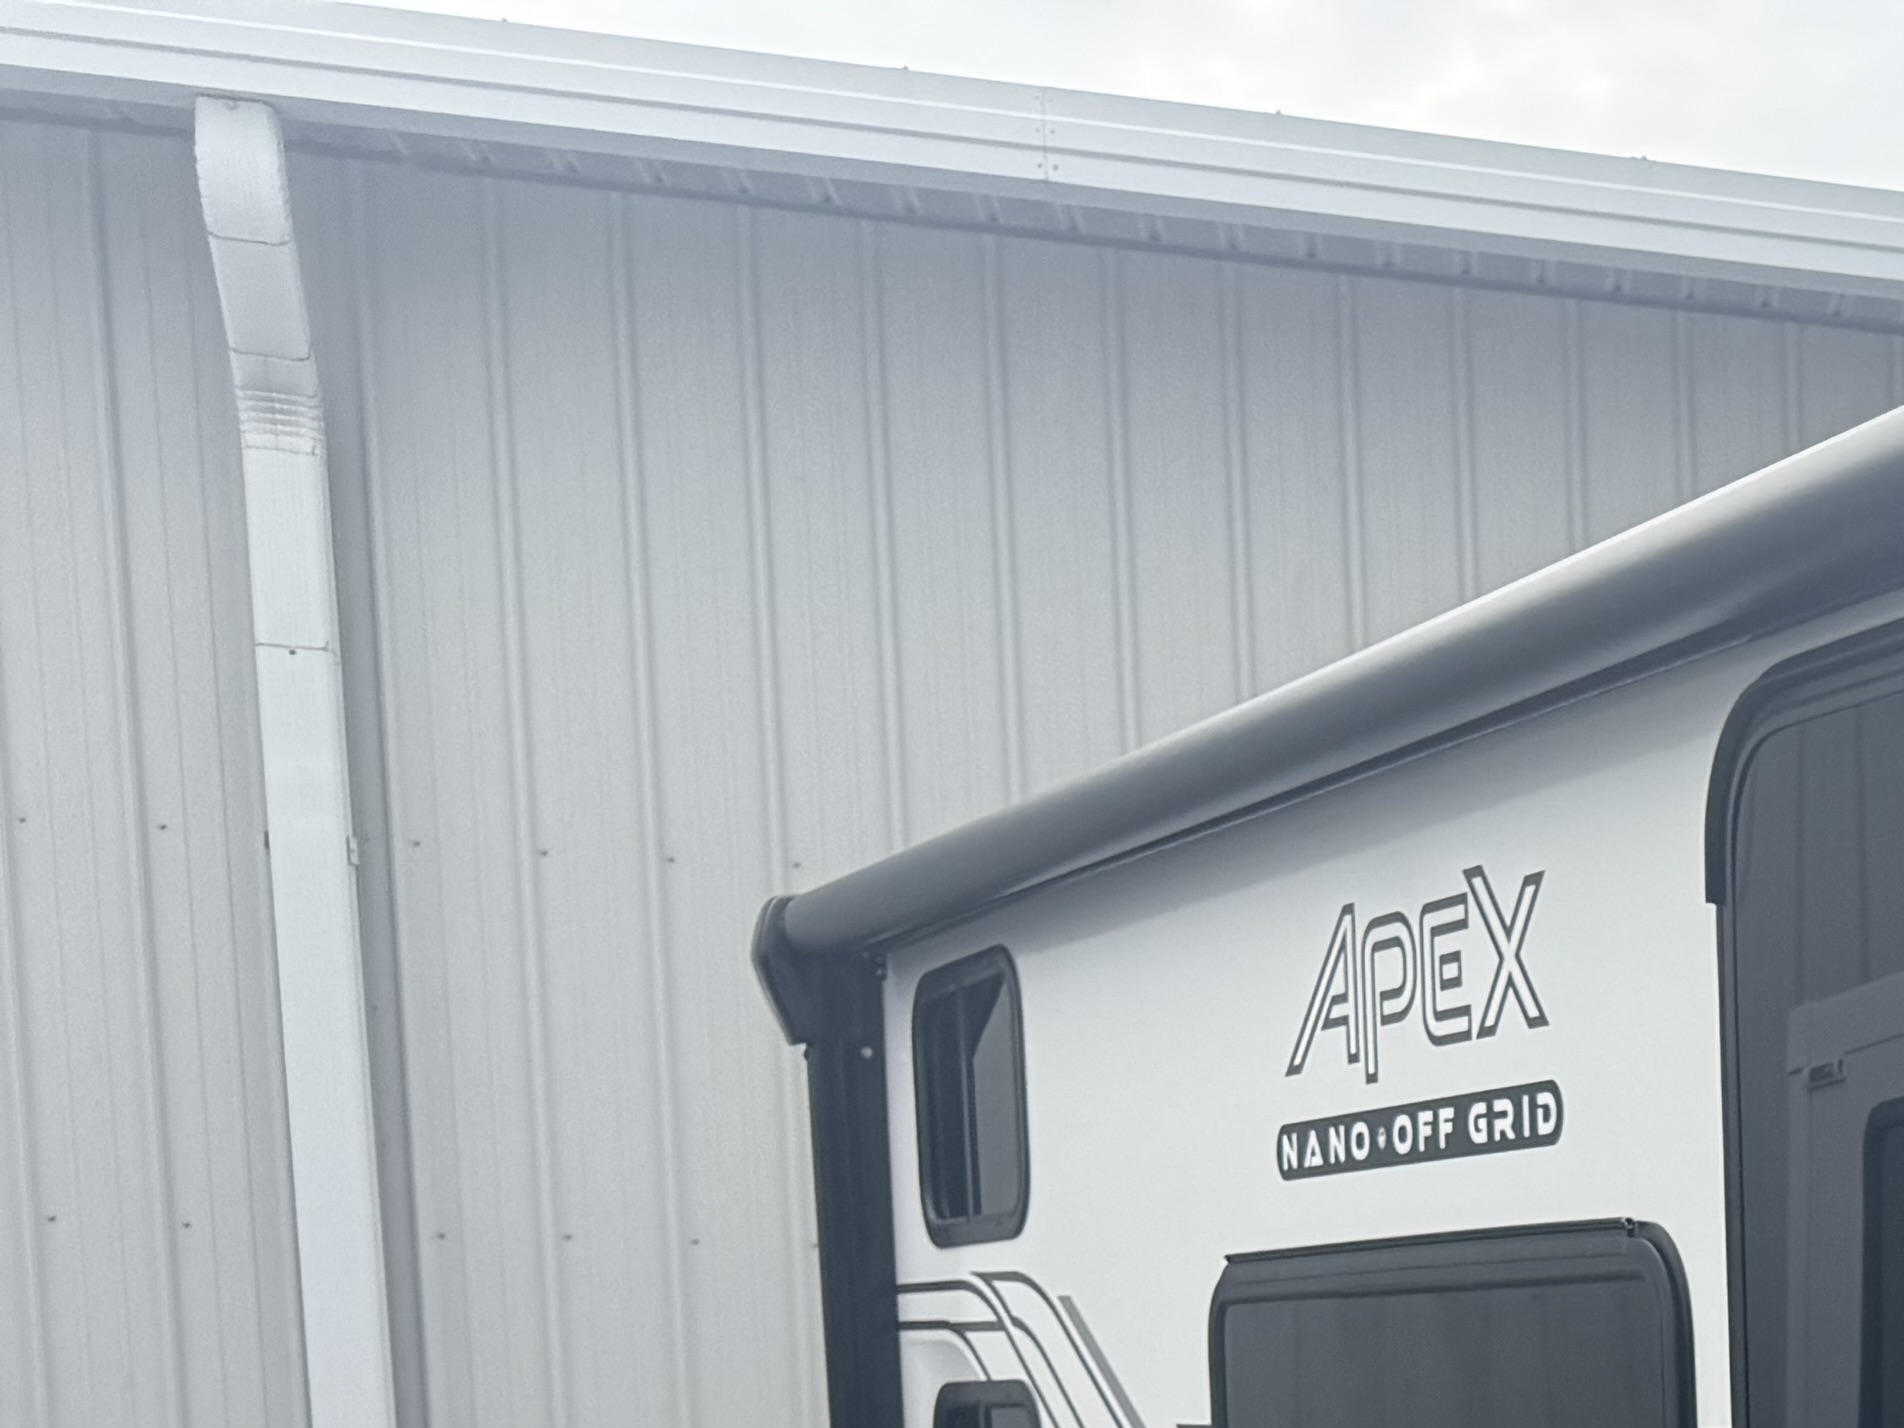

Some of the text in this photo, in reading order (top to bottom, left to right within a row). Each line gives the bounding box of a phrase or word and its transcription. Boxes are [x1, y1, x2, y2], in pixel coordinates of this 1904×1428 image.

[1285, 864, 1550, 1085] APEX
[1281, 1090, 1558, 1171] NANO OFF GRID
